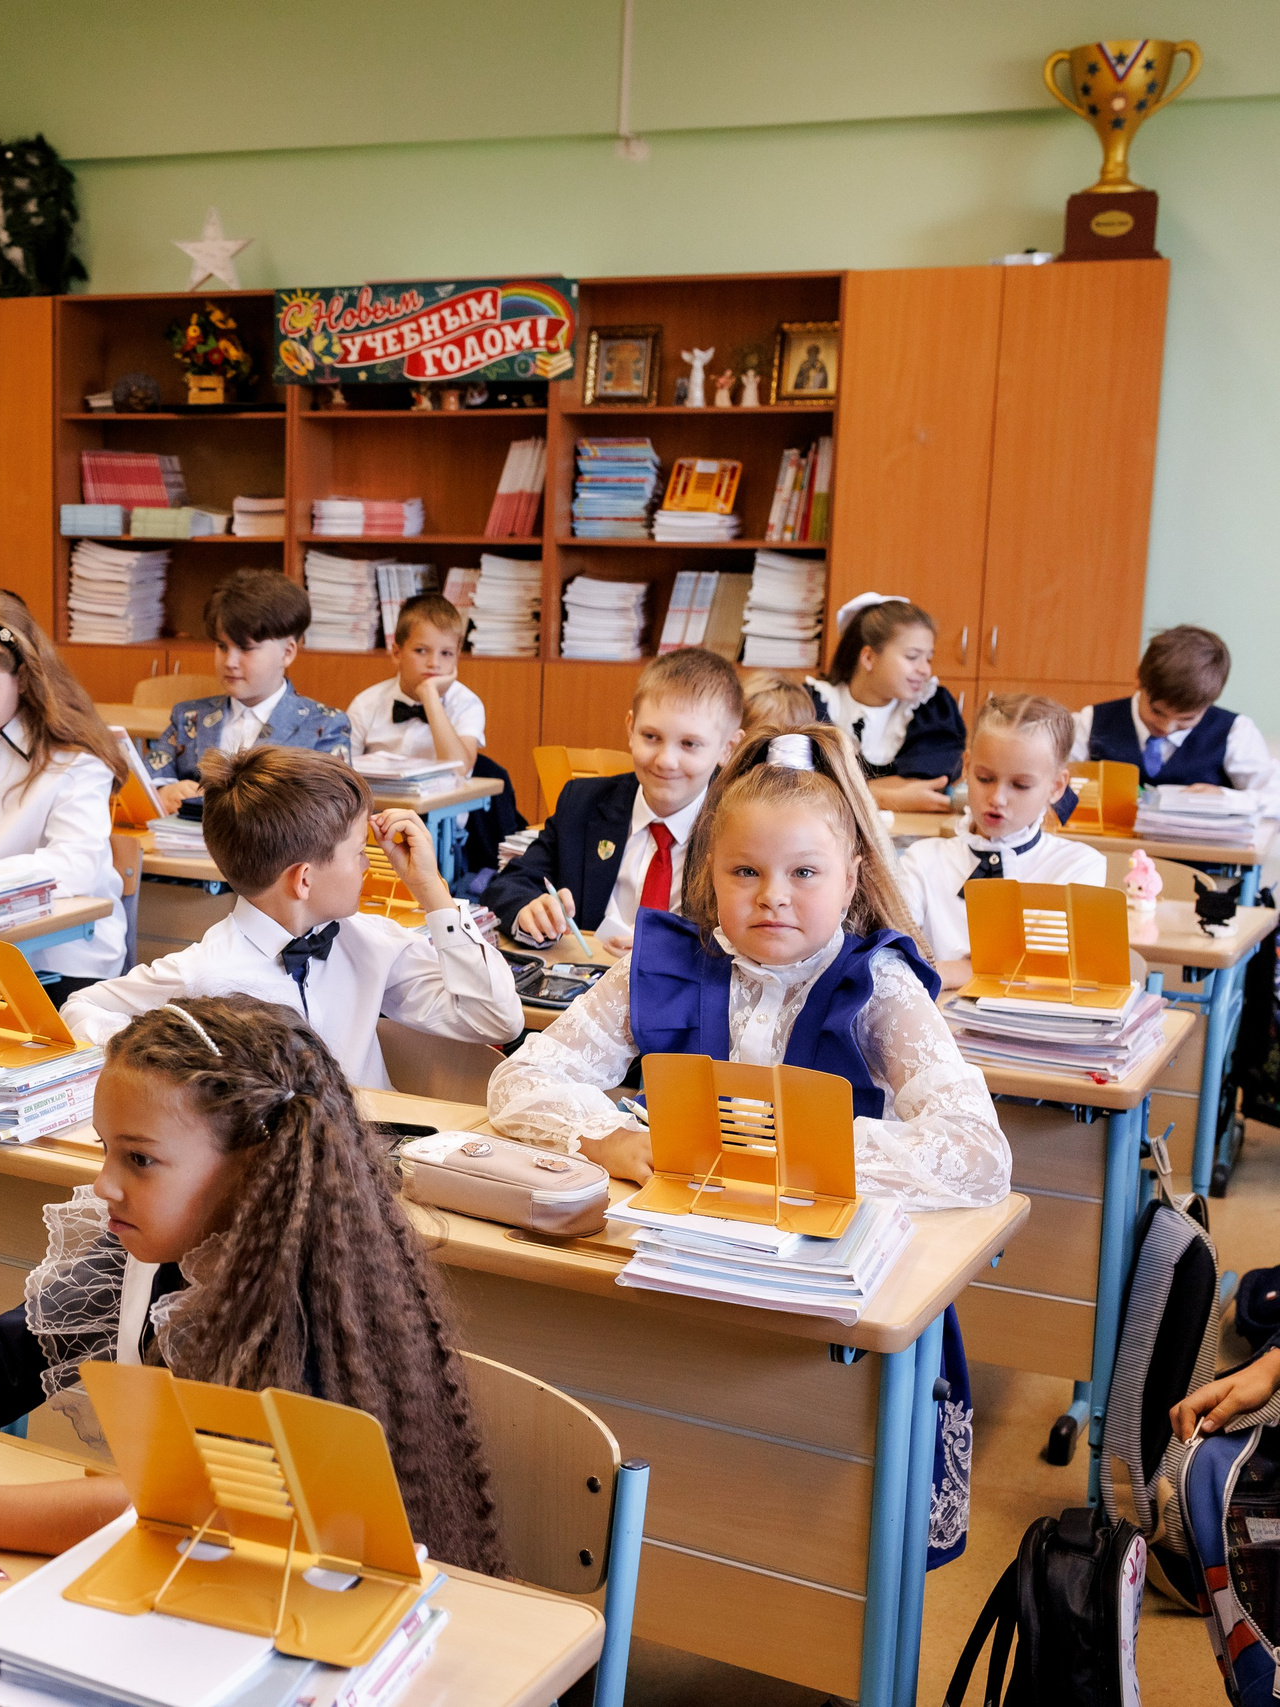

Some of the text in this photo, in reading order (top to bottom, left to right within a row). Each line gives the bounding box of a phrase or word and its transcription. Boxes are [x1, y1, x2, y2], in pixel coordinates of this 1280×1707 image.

[311, 286, 424, 335] Новым
[340, 289, 497, 362] УЧЕБНЫМ
[421, 317, 549, 376] ГОДОМ!
